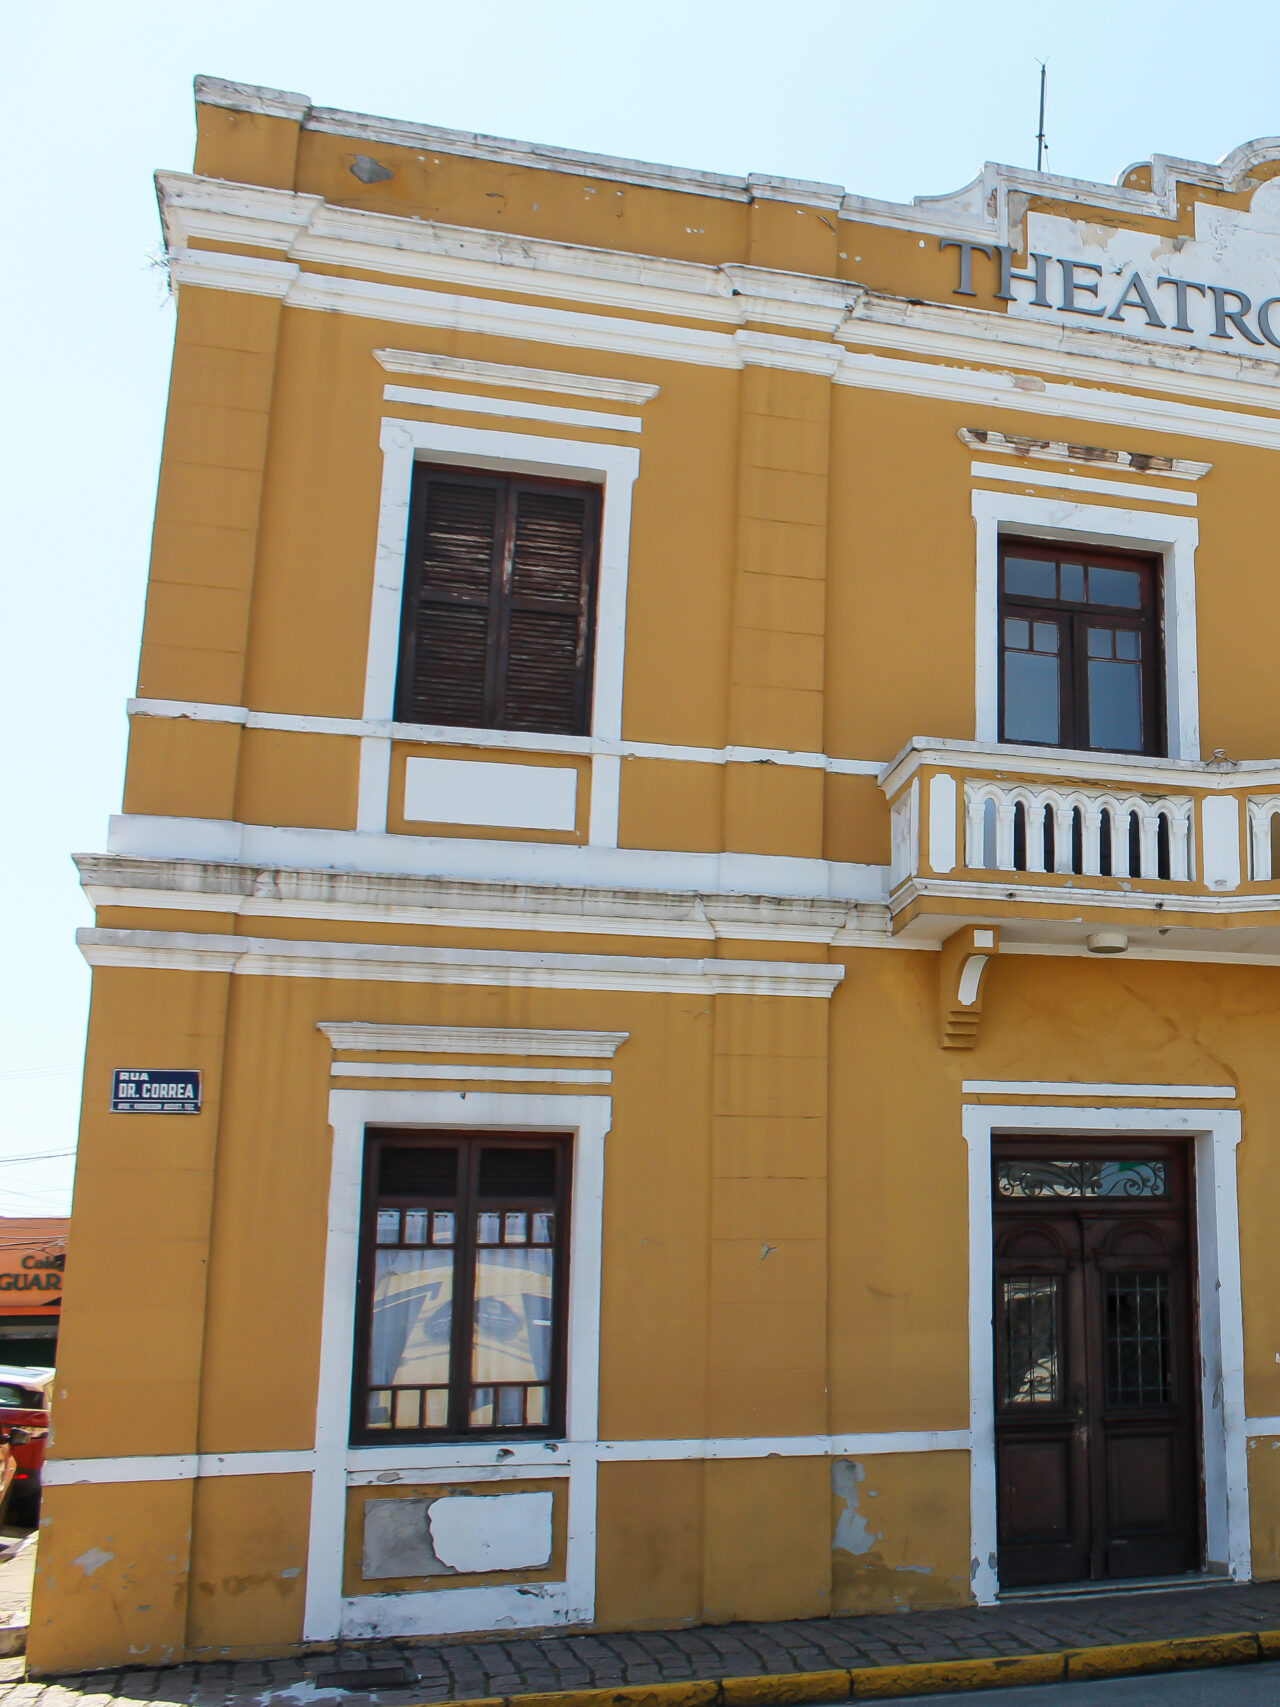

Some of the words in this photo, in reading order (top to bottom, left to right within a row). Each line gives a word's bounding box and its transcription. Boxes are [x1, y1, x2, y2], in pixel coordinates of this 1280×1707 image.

[119, 1072, 149, 1080] RUA
[118, 1083, 140, 1098] DR.
[142, 1083, 194, 1098] CORREA
